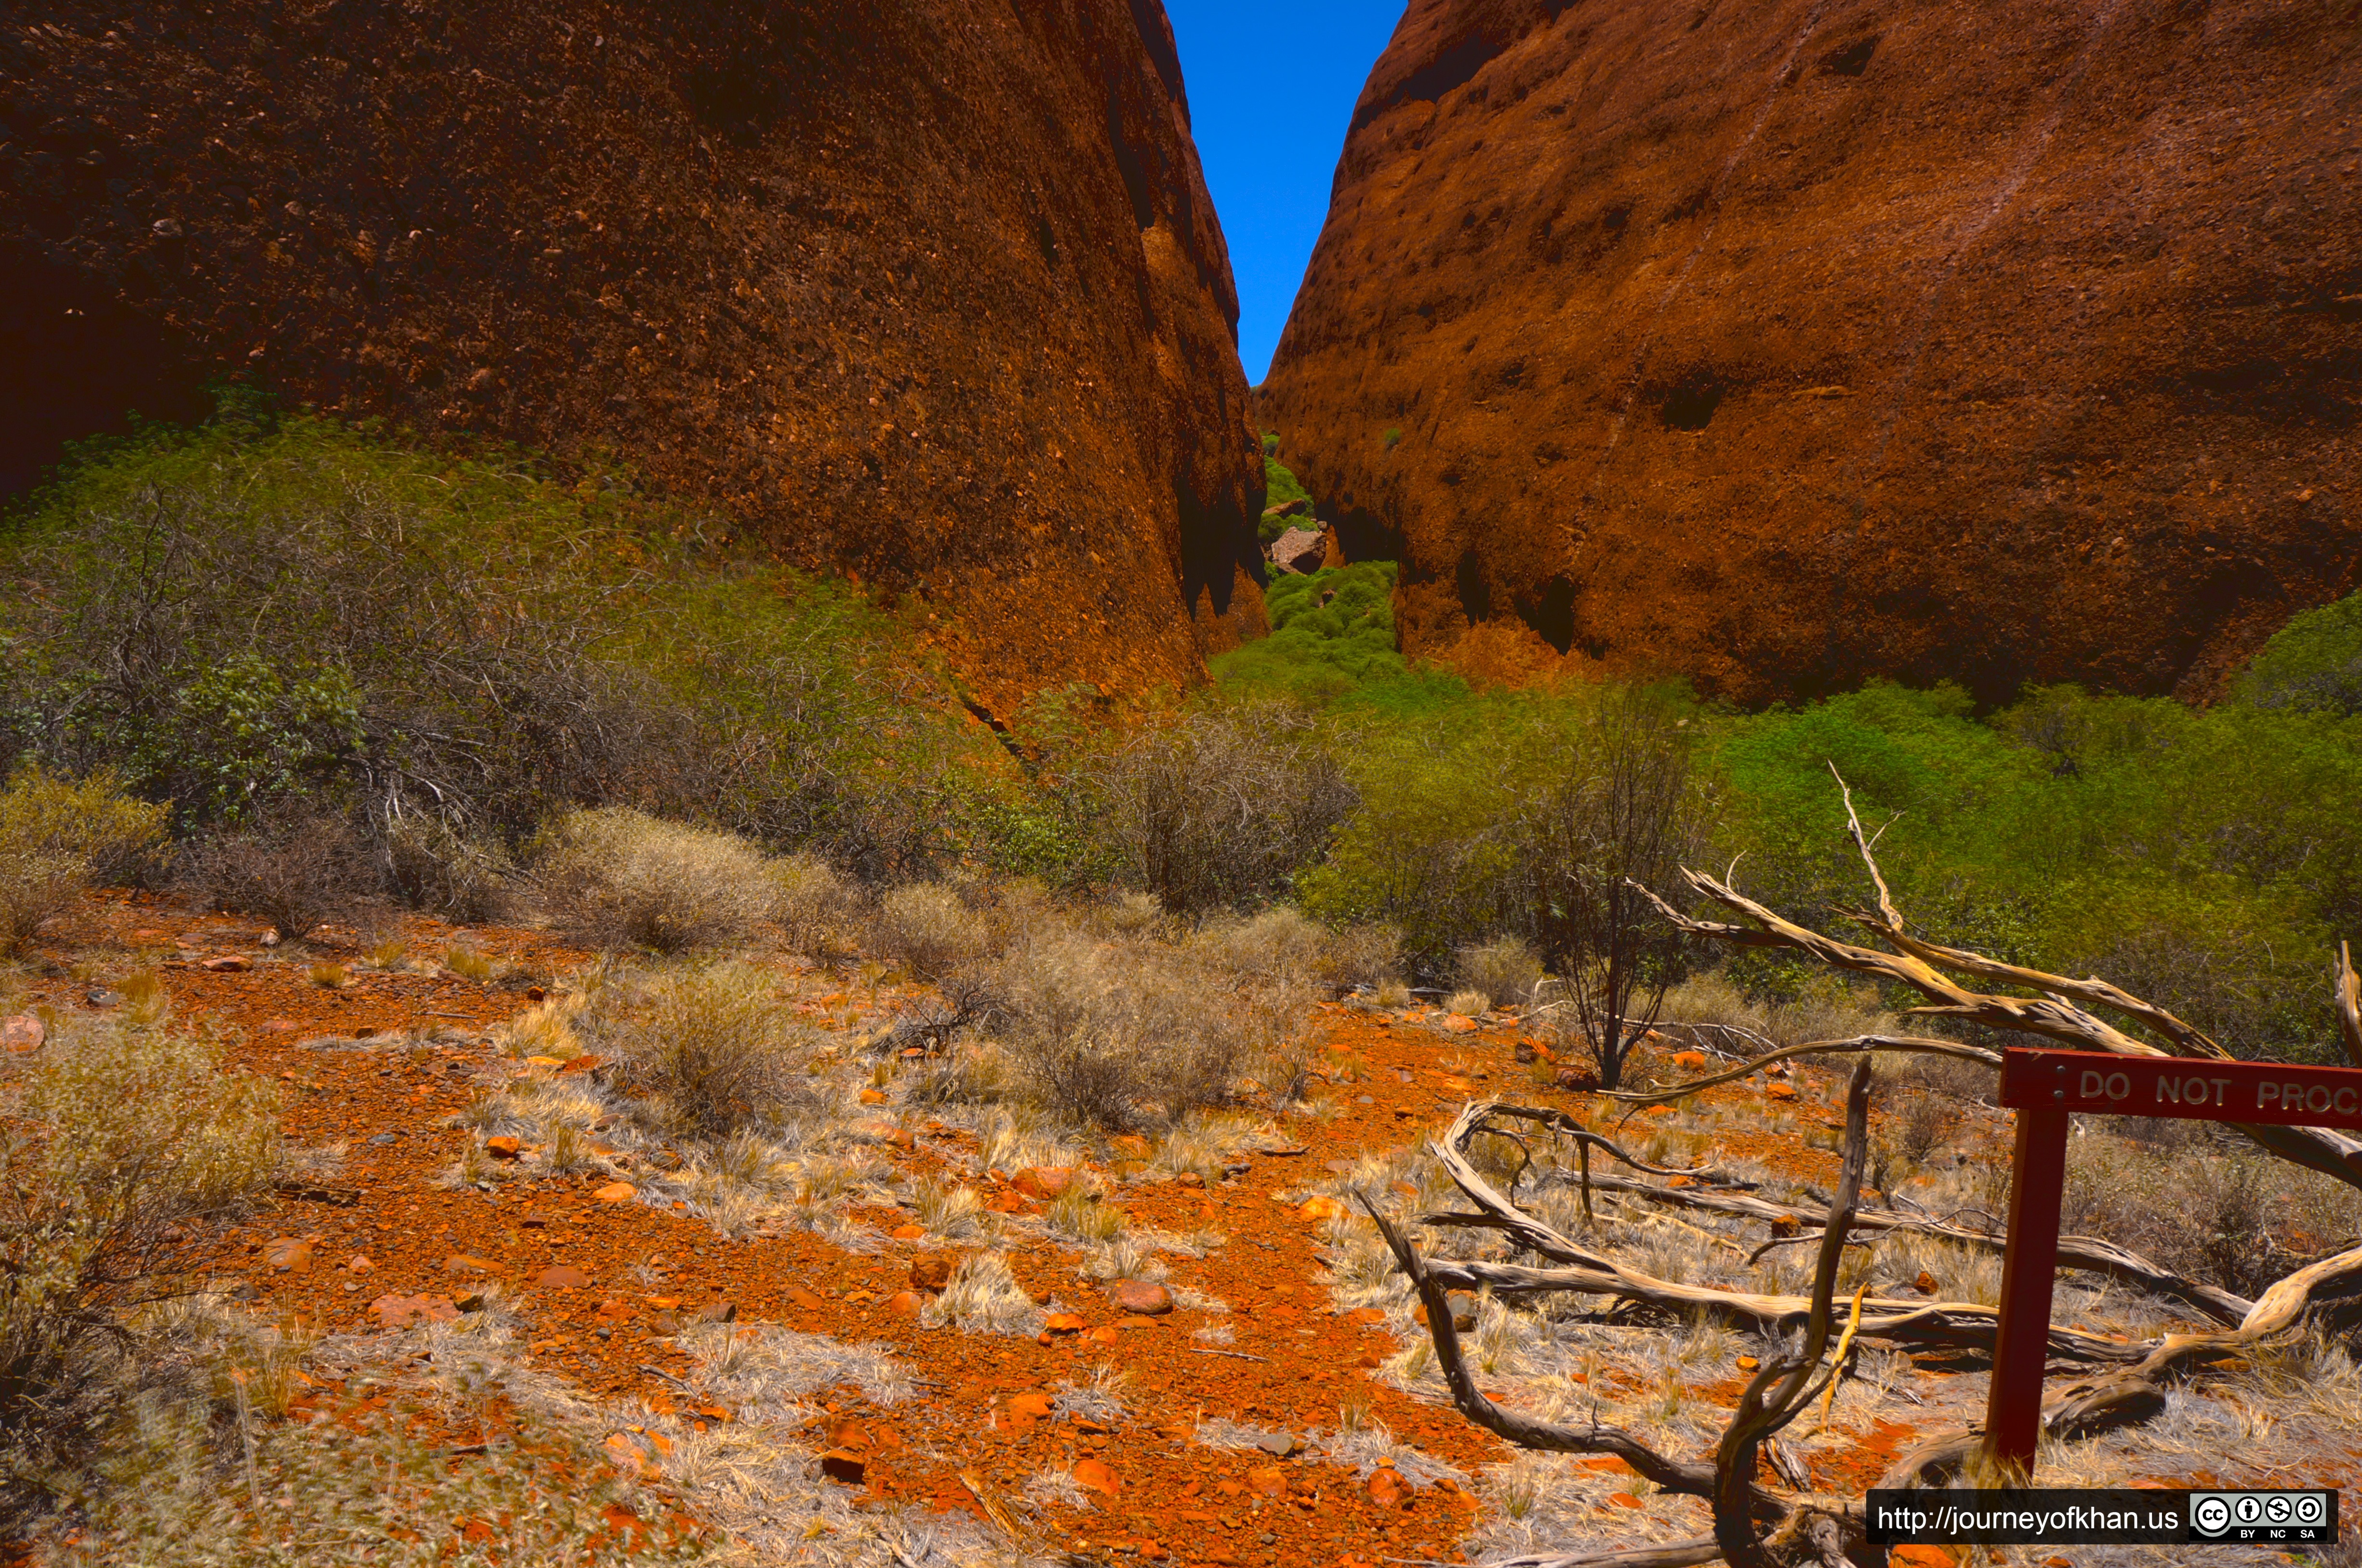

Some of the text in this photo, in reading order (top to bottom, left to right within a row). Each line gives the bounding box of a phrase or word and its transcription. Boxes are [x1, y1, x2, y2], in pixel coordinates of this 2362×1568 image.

[2080, 1070, 2362, 1114] DO NOT PROC
